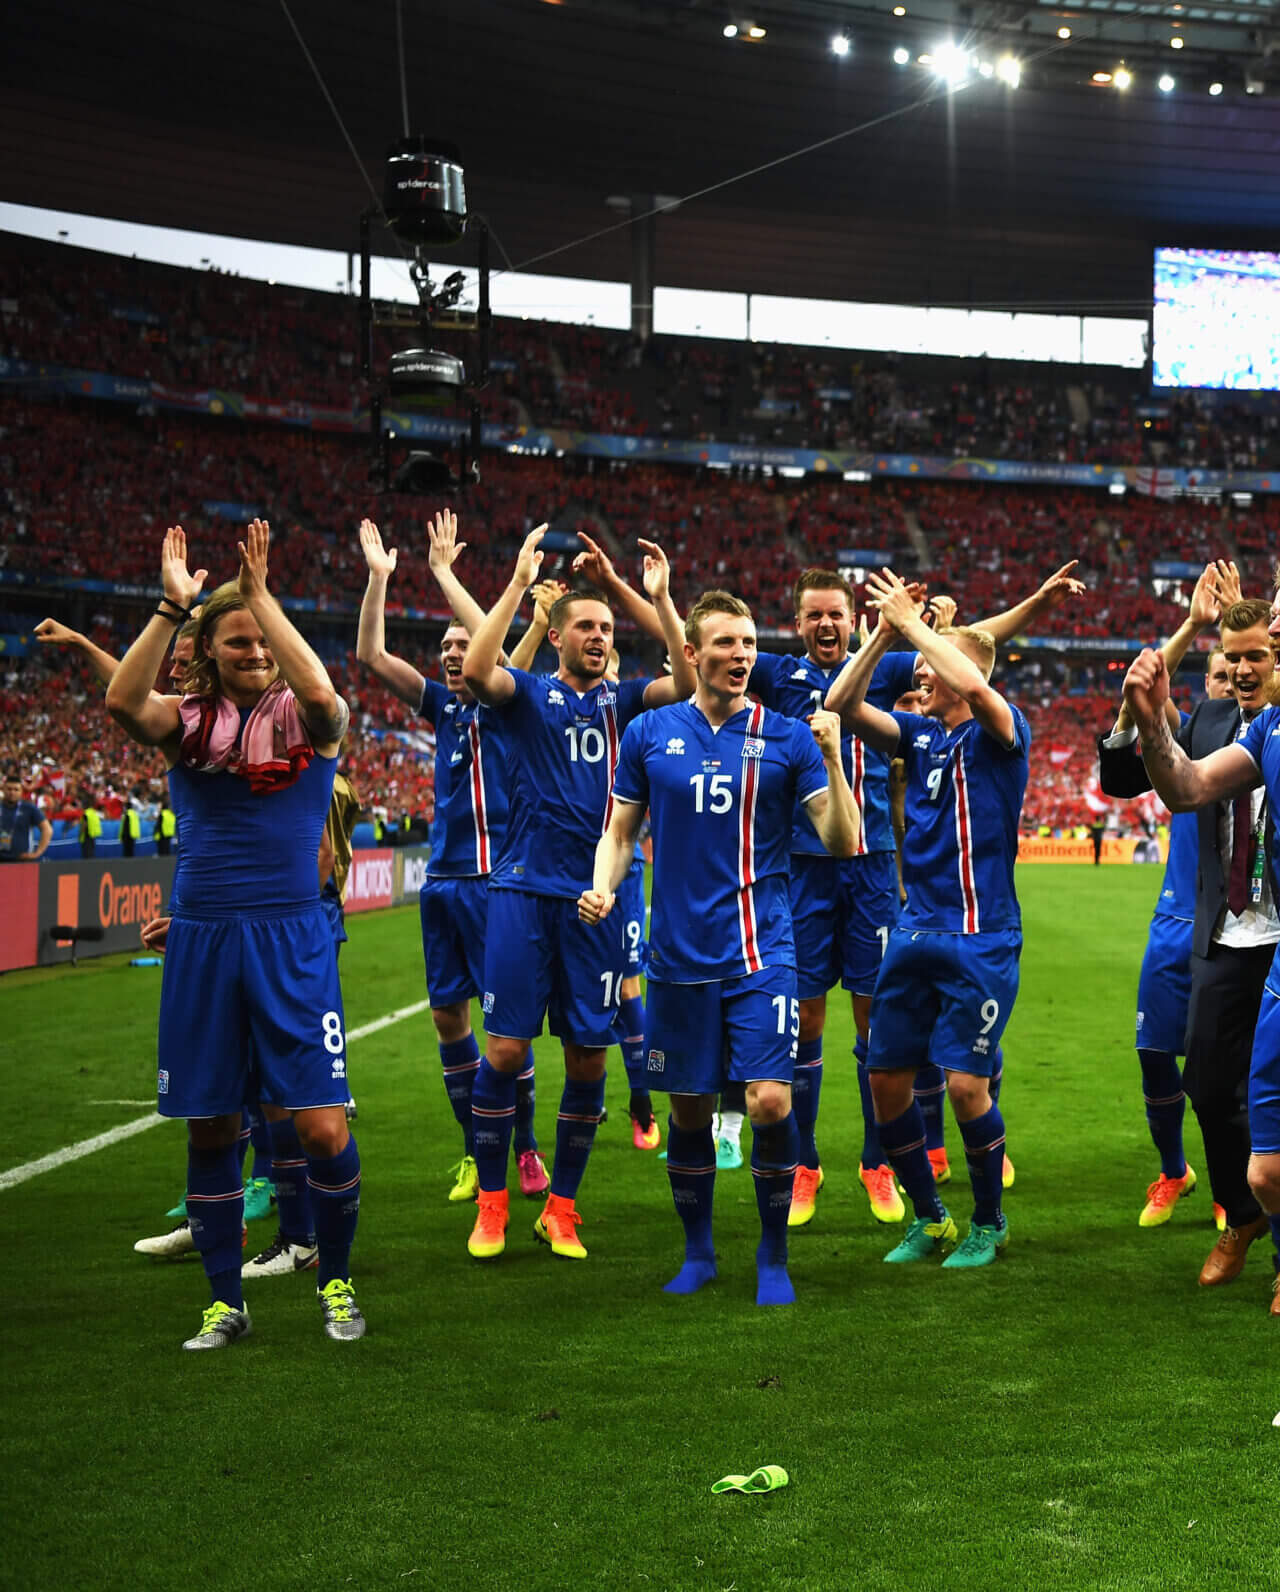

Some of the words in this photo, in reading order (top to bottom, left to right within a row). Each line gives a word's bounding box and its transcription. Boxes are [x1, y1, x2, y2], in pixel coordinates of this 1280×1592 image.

[565, 726, 605, 763] 10
[689, 773, 734, 815] 15
[926, 768, 943, 801] 9
[99, 872, 162, 934] Orange
[321, 1011, 344, 1055] 8
[772, 994, 800, 1038] 15
[980, 998, 999, 1035] 9
